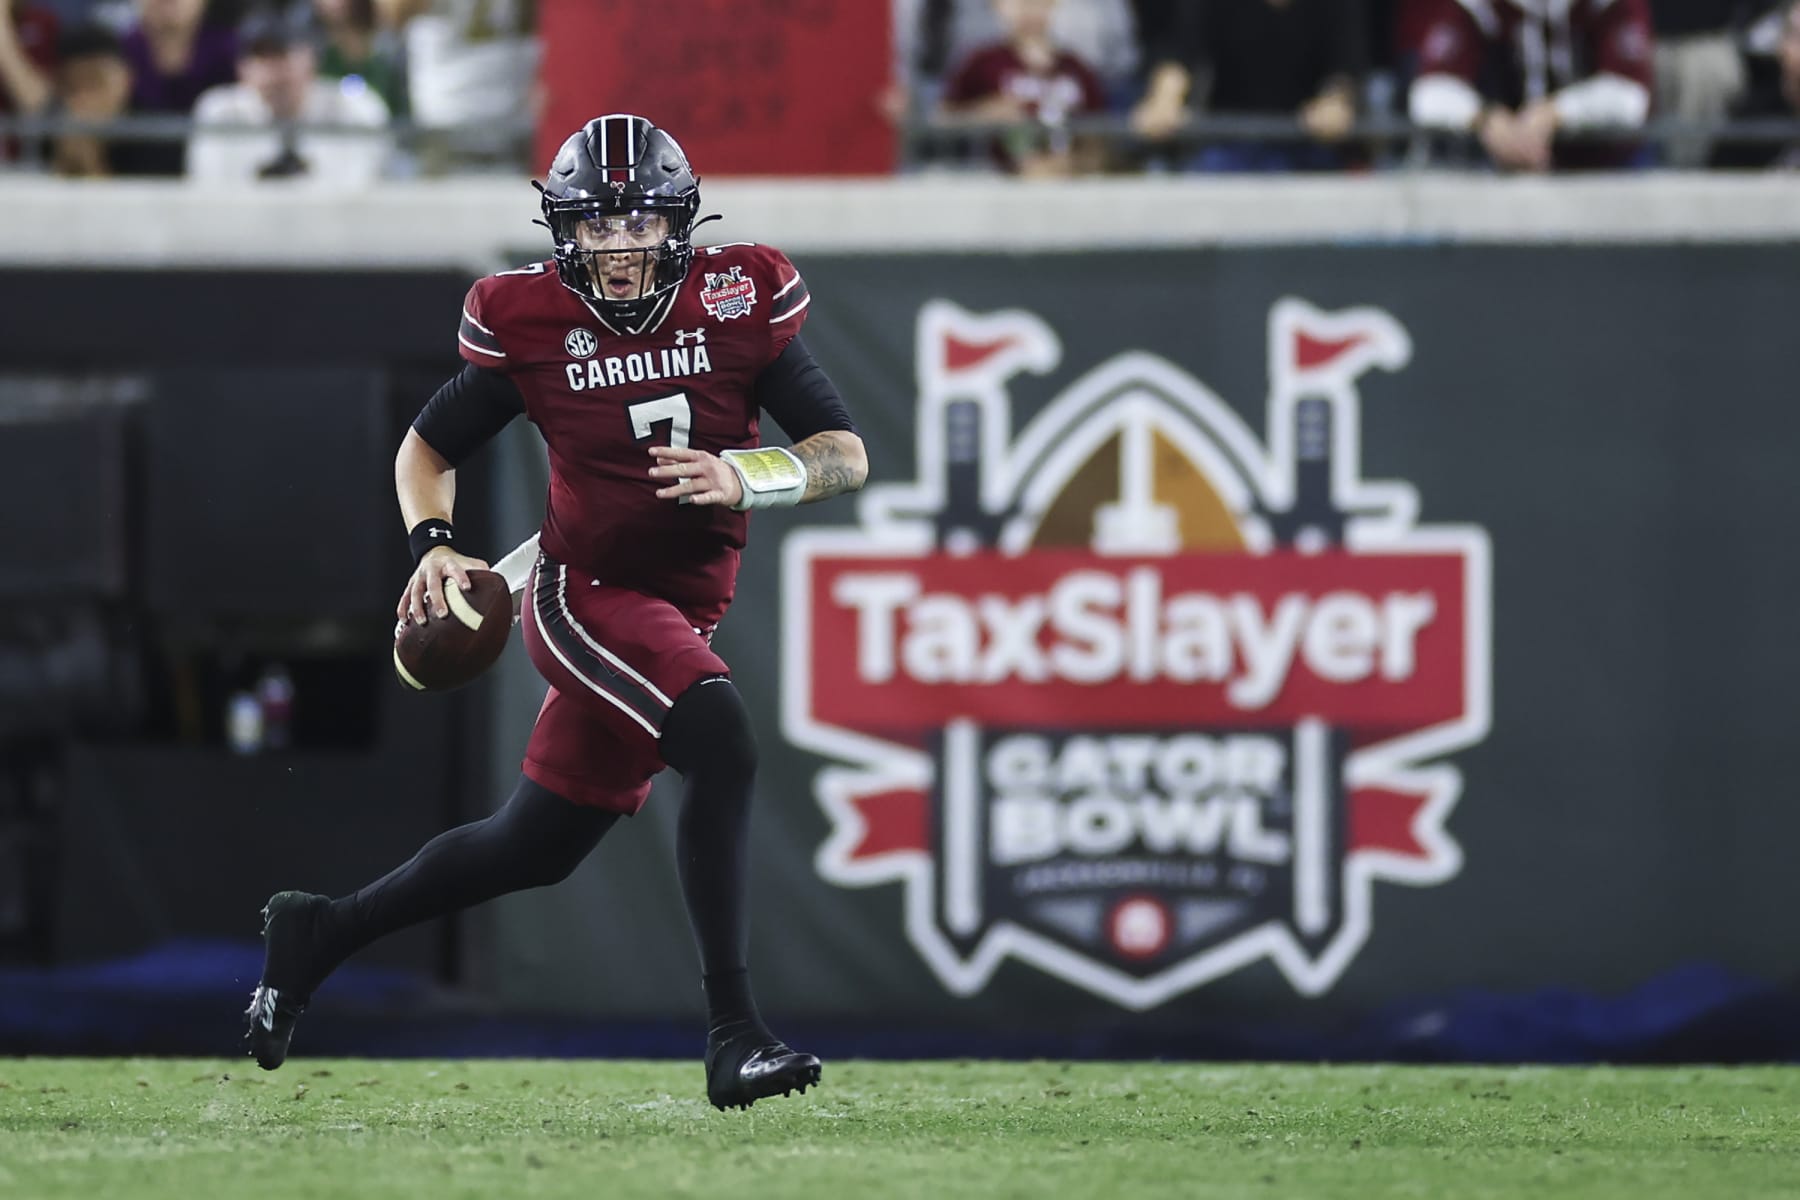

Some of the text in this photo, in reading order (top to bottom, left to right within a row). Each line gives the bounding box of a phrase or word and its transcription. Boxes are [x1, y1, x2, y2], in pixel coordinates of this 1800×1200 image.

[704, 283, 749, 300] TaxSlayer
[566, 345, 712, 391] CAROLINA
[567, 331, 595, 356] SEC
[628, 393, 691, 505] 7
[834, 569, 1434, 707] TaxSlayer
[989, 733, 1286, 794] GATOR
[991, 796, 1288, 863] BOWL
